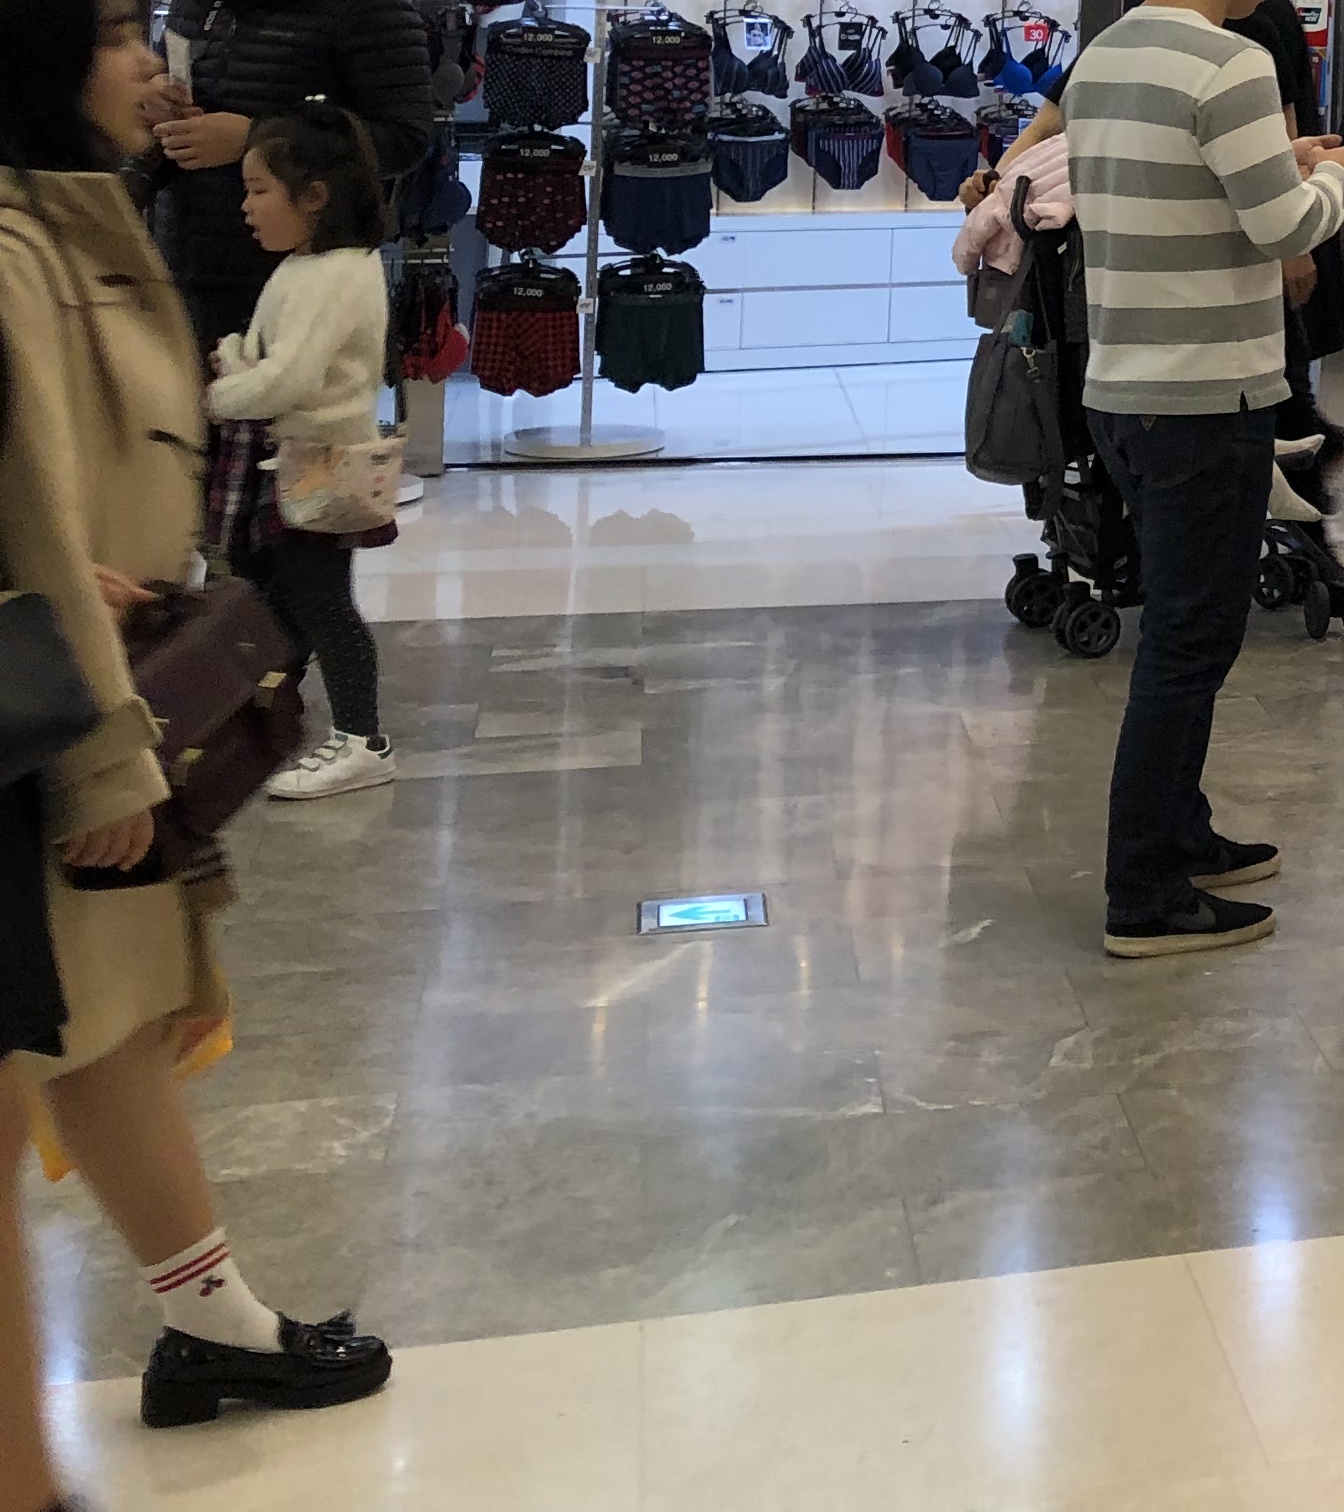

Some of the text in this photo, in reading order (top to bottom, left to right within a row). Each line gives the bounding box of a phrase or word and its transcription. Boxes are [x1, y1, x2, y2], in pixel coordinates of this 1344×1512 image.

[1029, 29, 1043, 40] 30
[519, 148, 550, 157] 12,000
[649, 153, 678, 161] 12,000
[513, 287, 543, 297] 12,000
